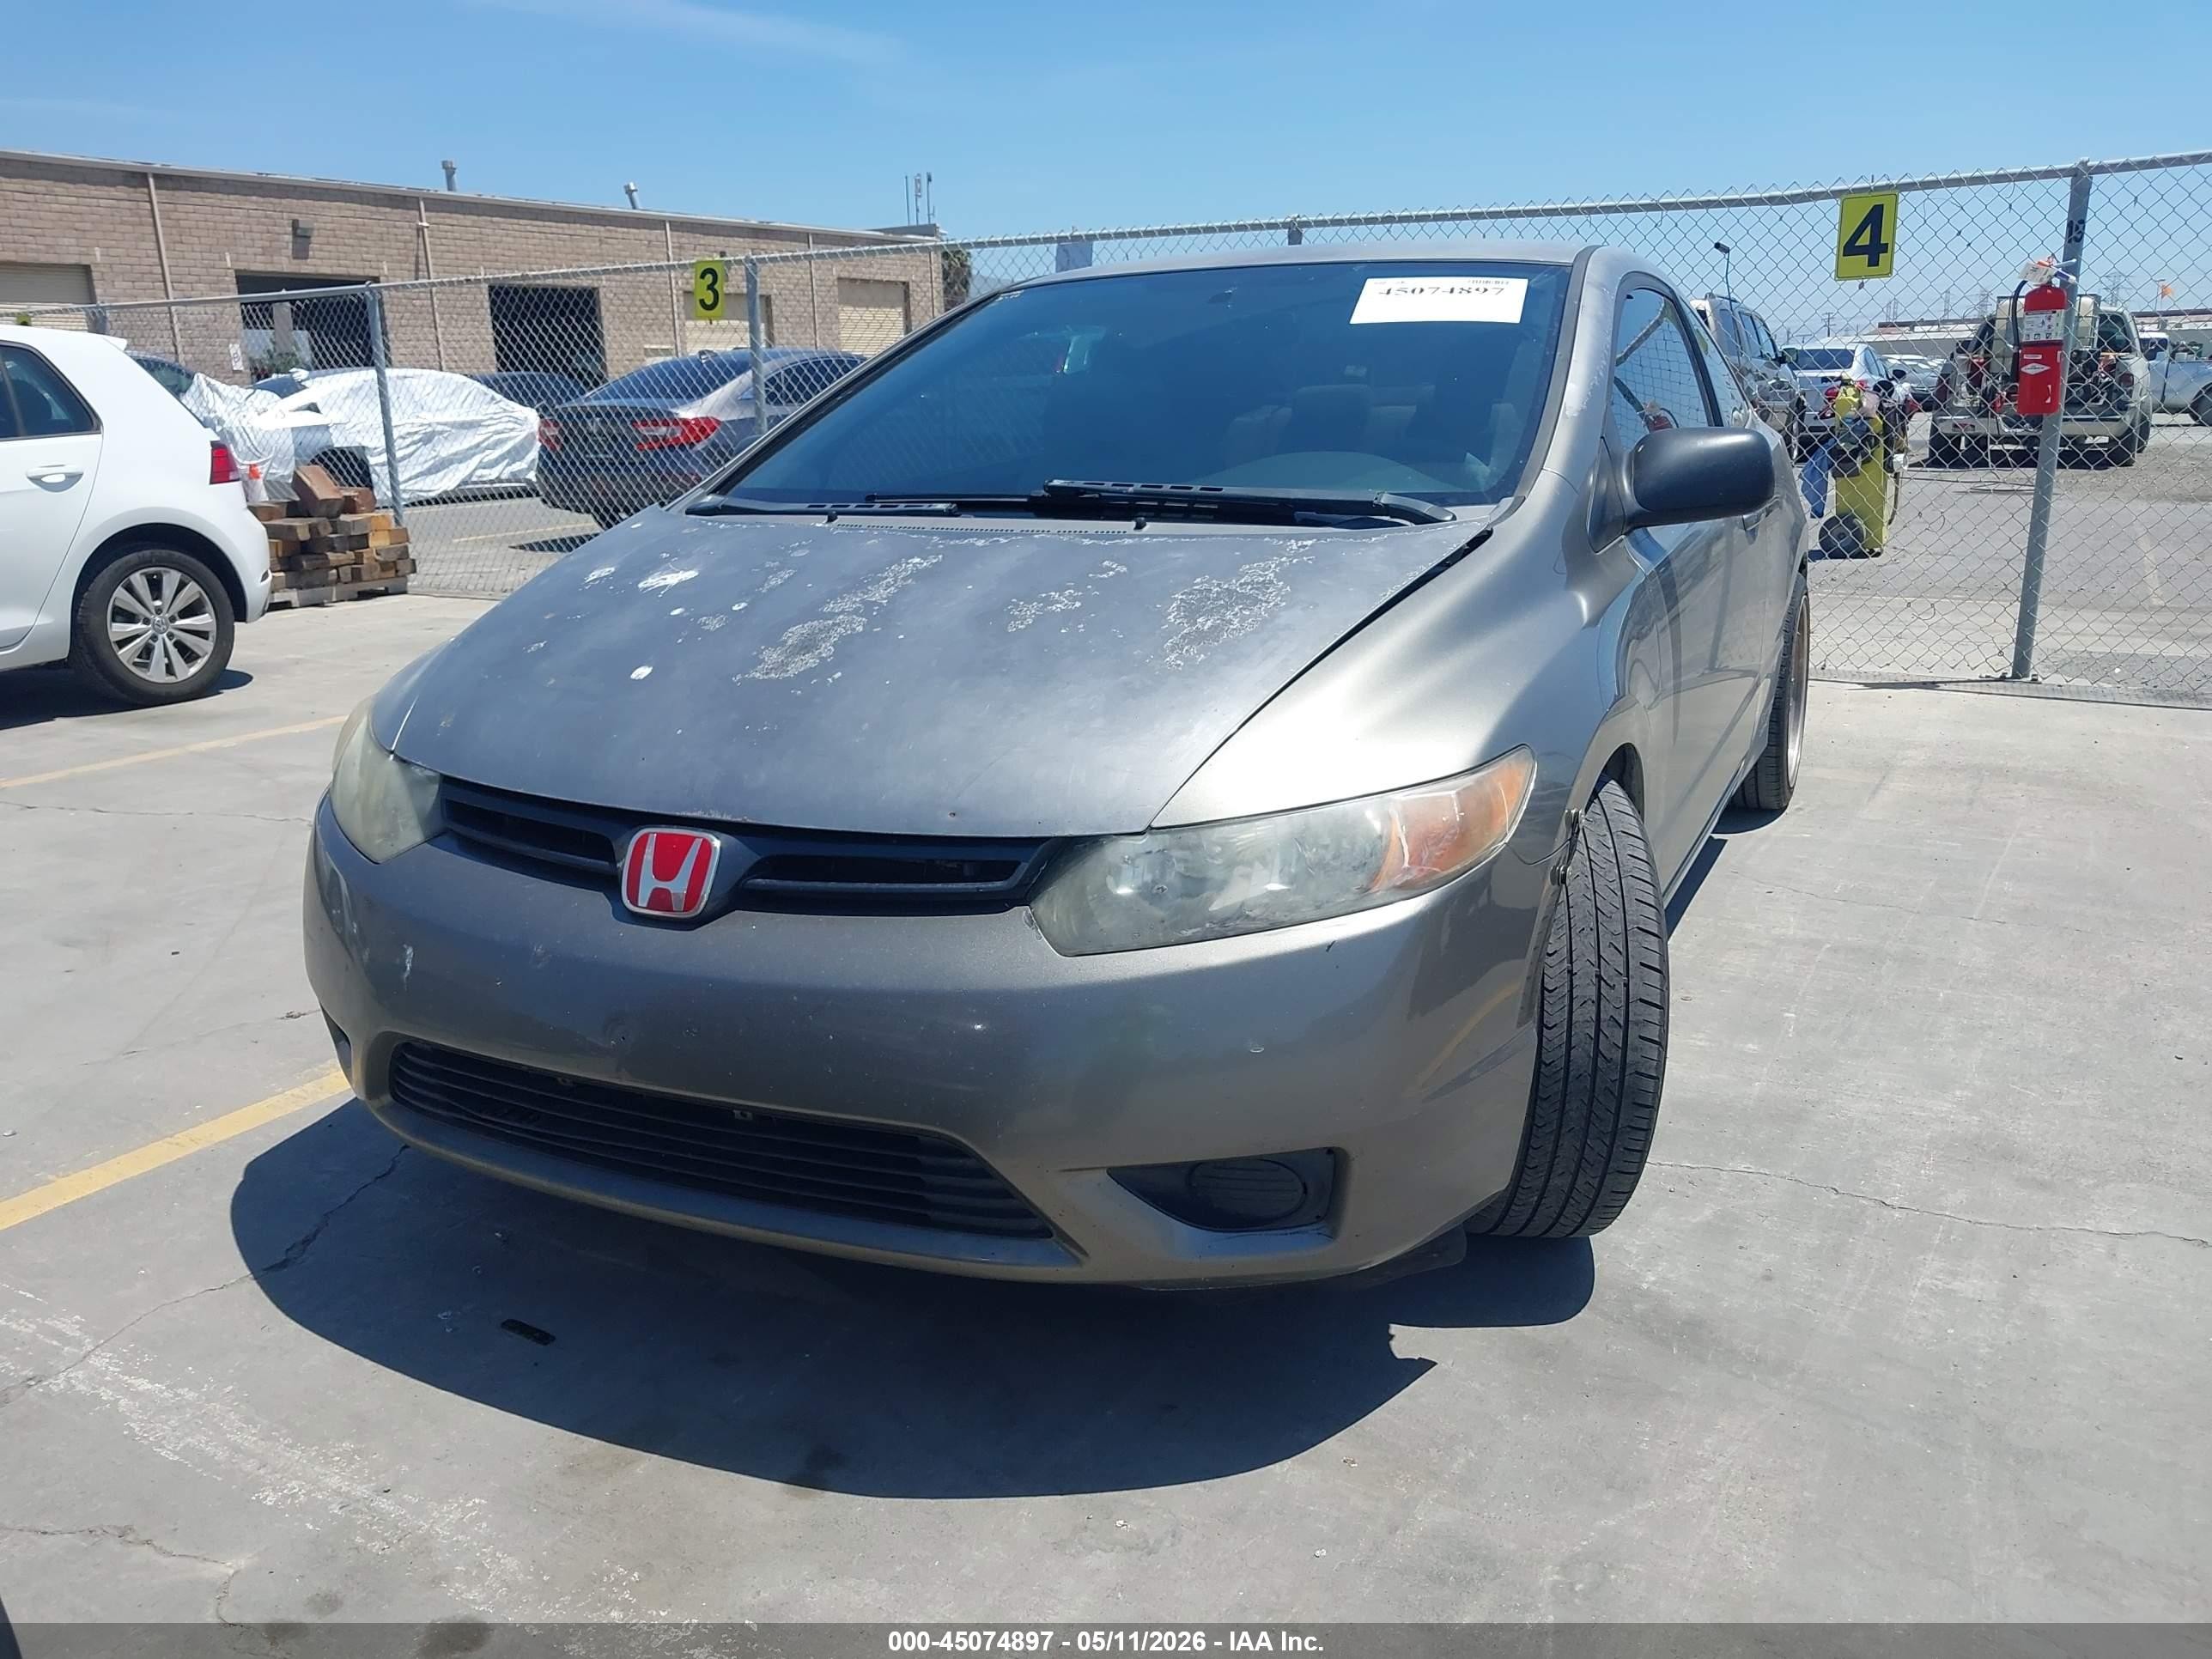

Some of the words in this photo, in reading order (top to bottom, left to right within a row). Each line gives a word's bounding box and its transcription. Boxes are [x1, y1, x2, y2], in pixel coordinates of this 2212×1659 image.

[1843, 204, 1888, 267] 4
[699, 268, 719, 311] 3
[1378, 286, 1505, 296] 45074897
